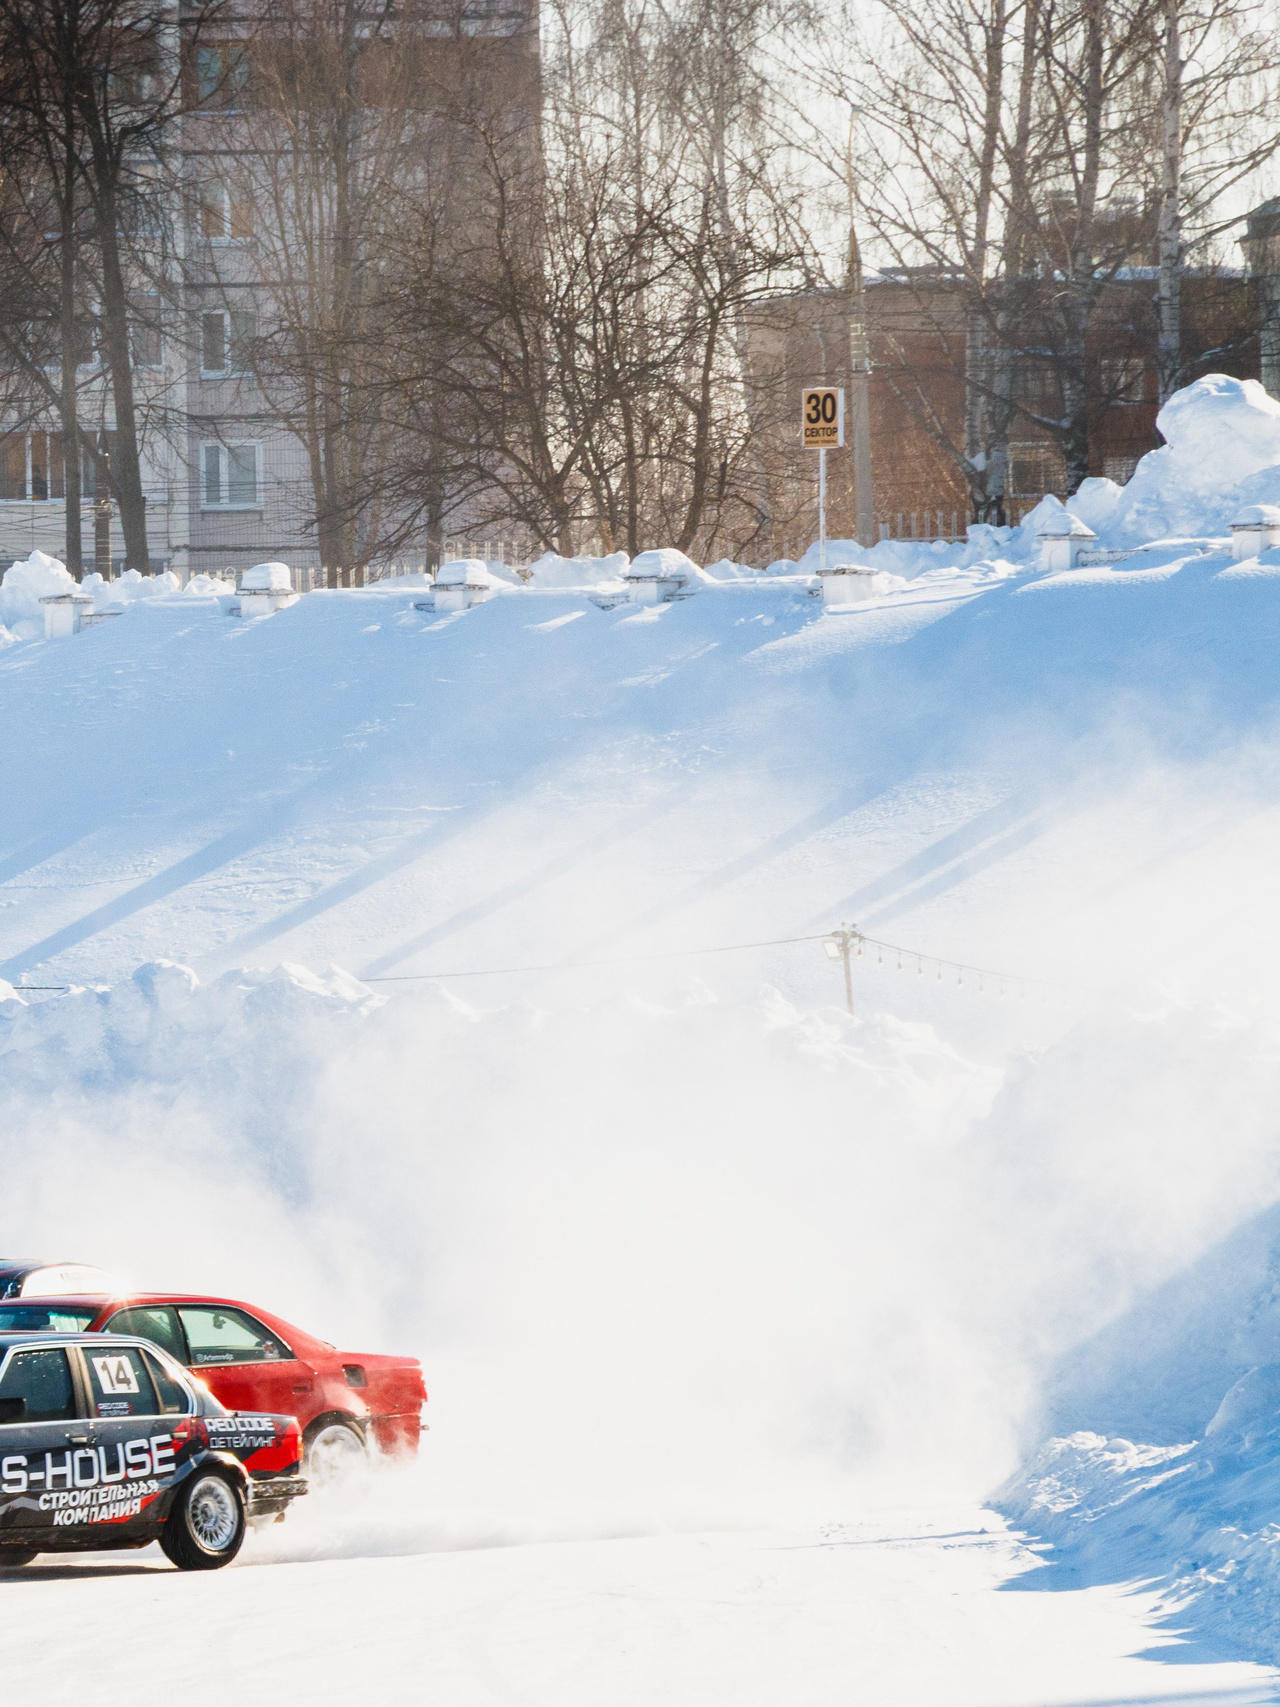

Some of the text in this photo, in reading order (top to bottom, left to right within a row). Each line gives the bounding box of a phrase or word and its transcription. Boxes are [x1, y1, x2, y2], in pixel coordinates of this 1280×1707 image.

[806, 393, 836, 424] 30
[804, 427, 838, 438] СЕКТОР
[101, 1360, 131, 1390] 14
[204, 1417, 275, 1432] RED CODE
[209, 1433, 276, 1448] ДЕТЕЙЛИНГ
[1, 1434, 177, 1494] S-HOUSE
[38, 1479, 160, 1511] СТРОИТЕЛЬНАЯ
[53, 1498, 142, 1526] КОМПАНИЯ
